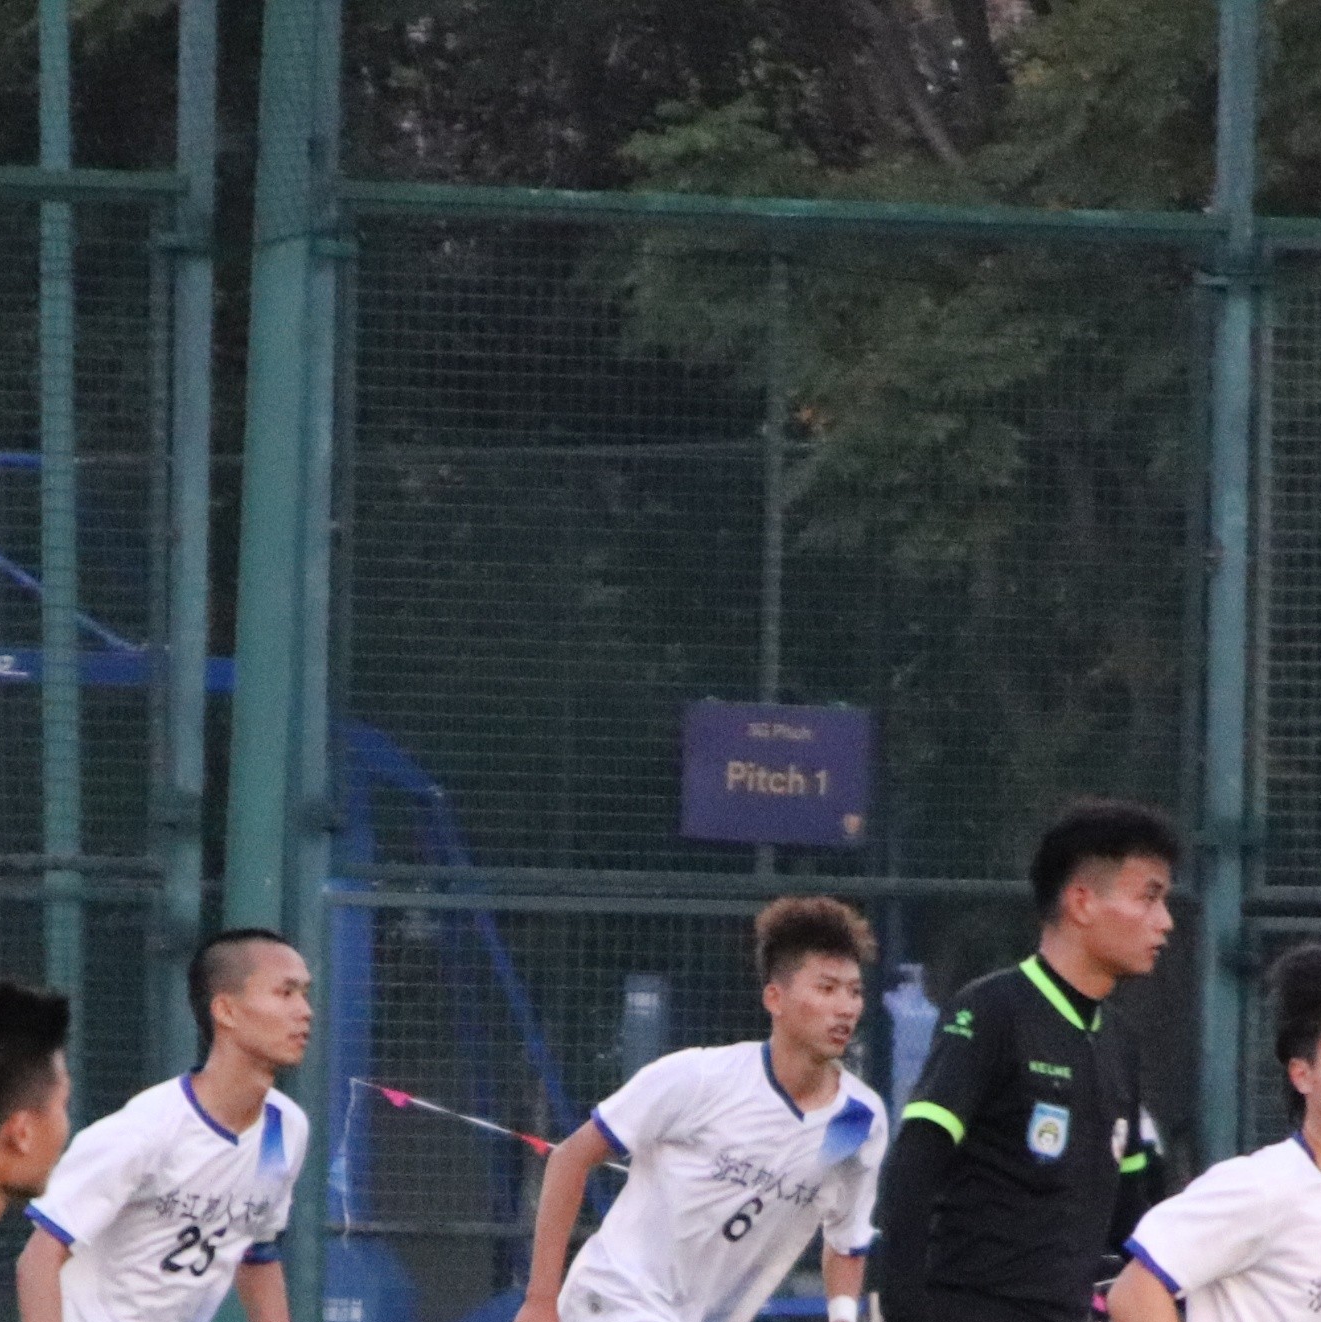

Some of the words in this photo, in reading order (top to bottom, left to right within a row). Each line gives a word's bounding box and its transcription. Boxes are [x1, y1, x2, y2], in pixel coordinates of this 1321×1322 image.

[726, 760, 806, 795] Pitch
[815, 769, 829, 796] 1
[722, 1197, 764, 1242] 6
[160, 1225, 227, 1276] 25
